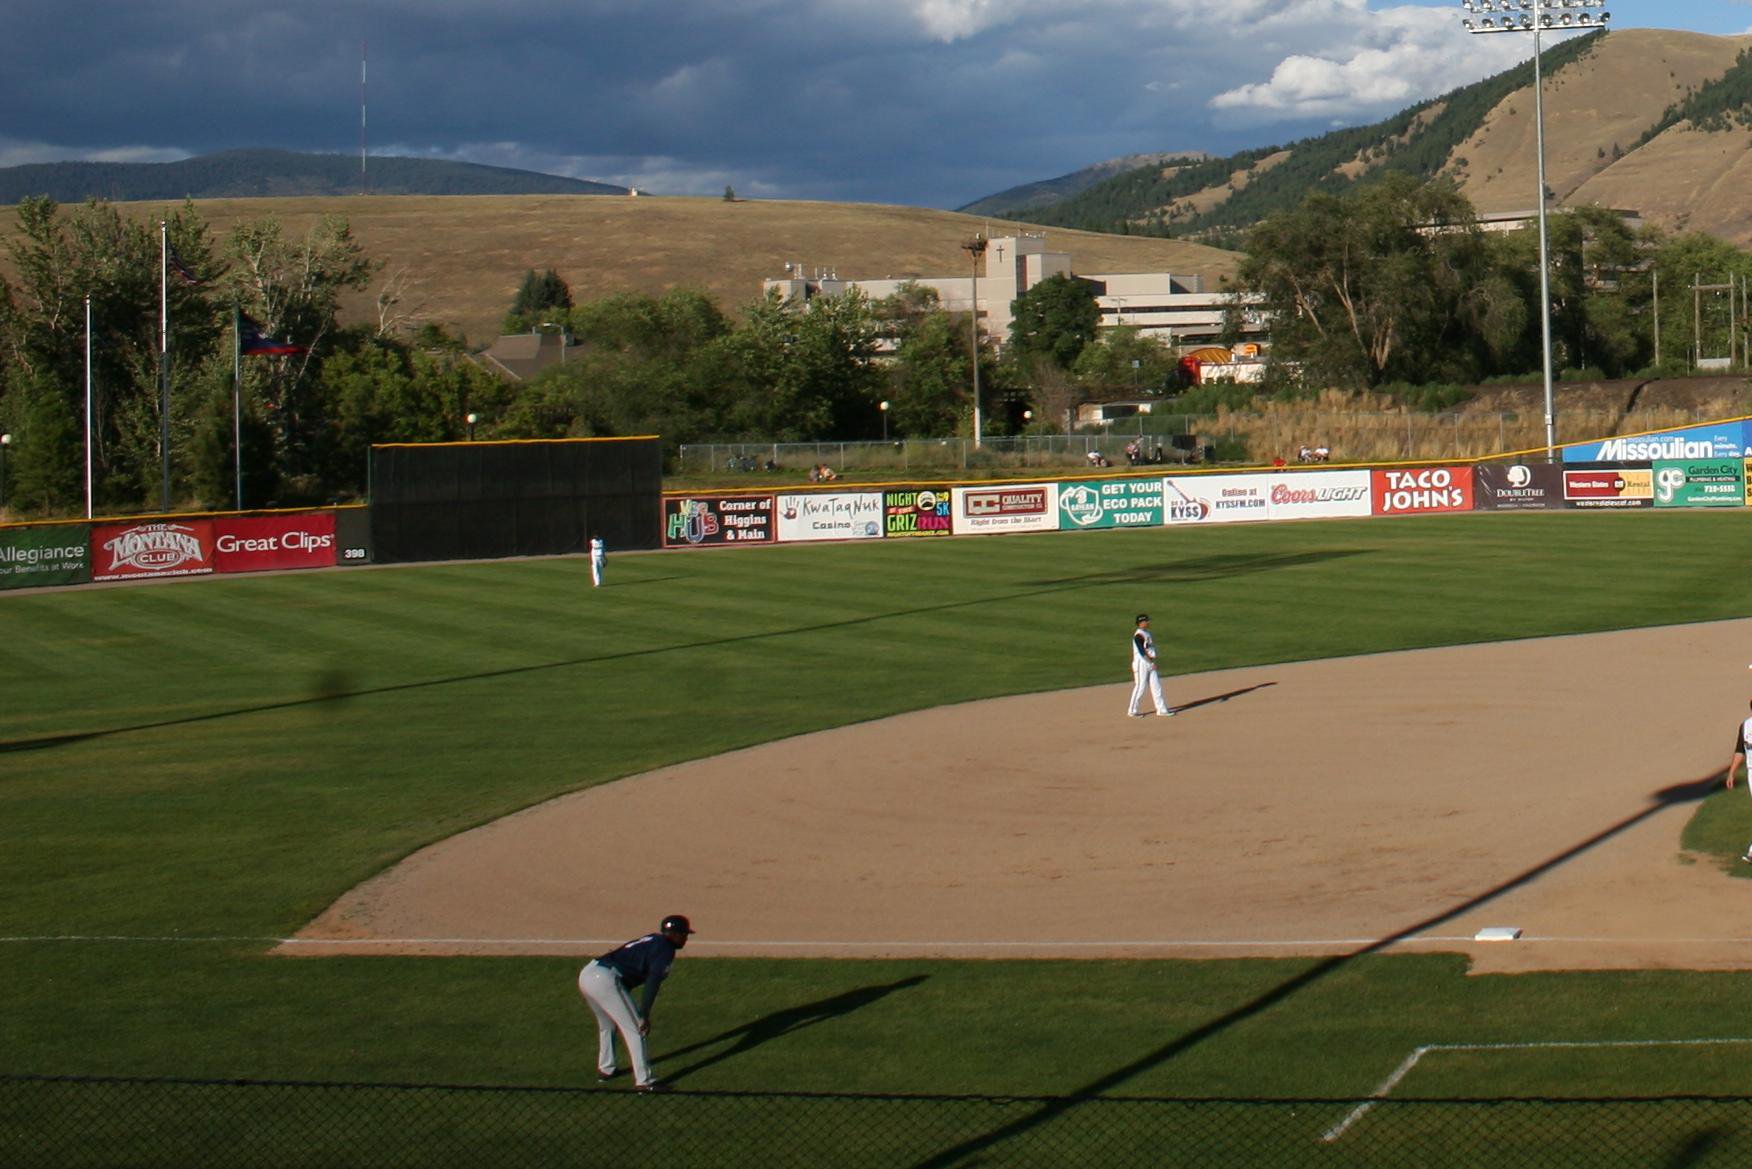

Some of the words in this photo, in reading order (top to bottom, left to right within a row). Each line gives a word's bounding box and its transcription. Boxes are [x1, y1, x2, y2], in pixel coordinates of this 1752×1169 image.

[1596, 437, 1713, 460] Missoulian
[1688, 465, 1719, 475] Garden
[1720, 464, 1737, 475] City
[1386, 470, 1451, 490] TACO
[1102, 483, 1126, 495] GET
[1129, 482, 1162, 494] YOUR
[1271, 483, 1318, 504] Coors
[1316, 486, 1368, 501] LIGHT
[720, 500, 756, 511] Corner
[759, 499, 771, 510] of
[887, 492, 918, 506] NIGHT
[1002, 494, 1043, 504] QUALITY
[1103, 498, 1127, 510] ECO
[1131, 497, 1162, 508] PACK
[1216, 499, 1265, 509] KYSSFM.COM
[1383, 486, 1462, 512] JOHN'S
[936, 502, 950, 516] 5K
[1171, 505, 1199, 518] KYSS
[724, 515, 767, 527] Higgins
[887, 514, 917, 531] GRIZ
[1113, 511, 1153, 523] TODAY
[668, 512, 719, 544] HUB
[812, 521, 851, 529] Casino
[726, 529, 735, 540] &
[738, 529, 765, 539] Main
[217, 535, 278, 552] Great
[281, 532, 331, 552] Clips
[103, 531, 203, 570] MONTANA
[344, 549, 365, 559] 398
[140, 553, 176, 563] CLUB
